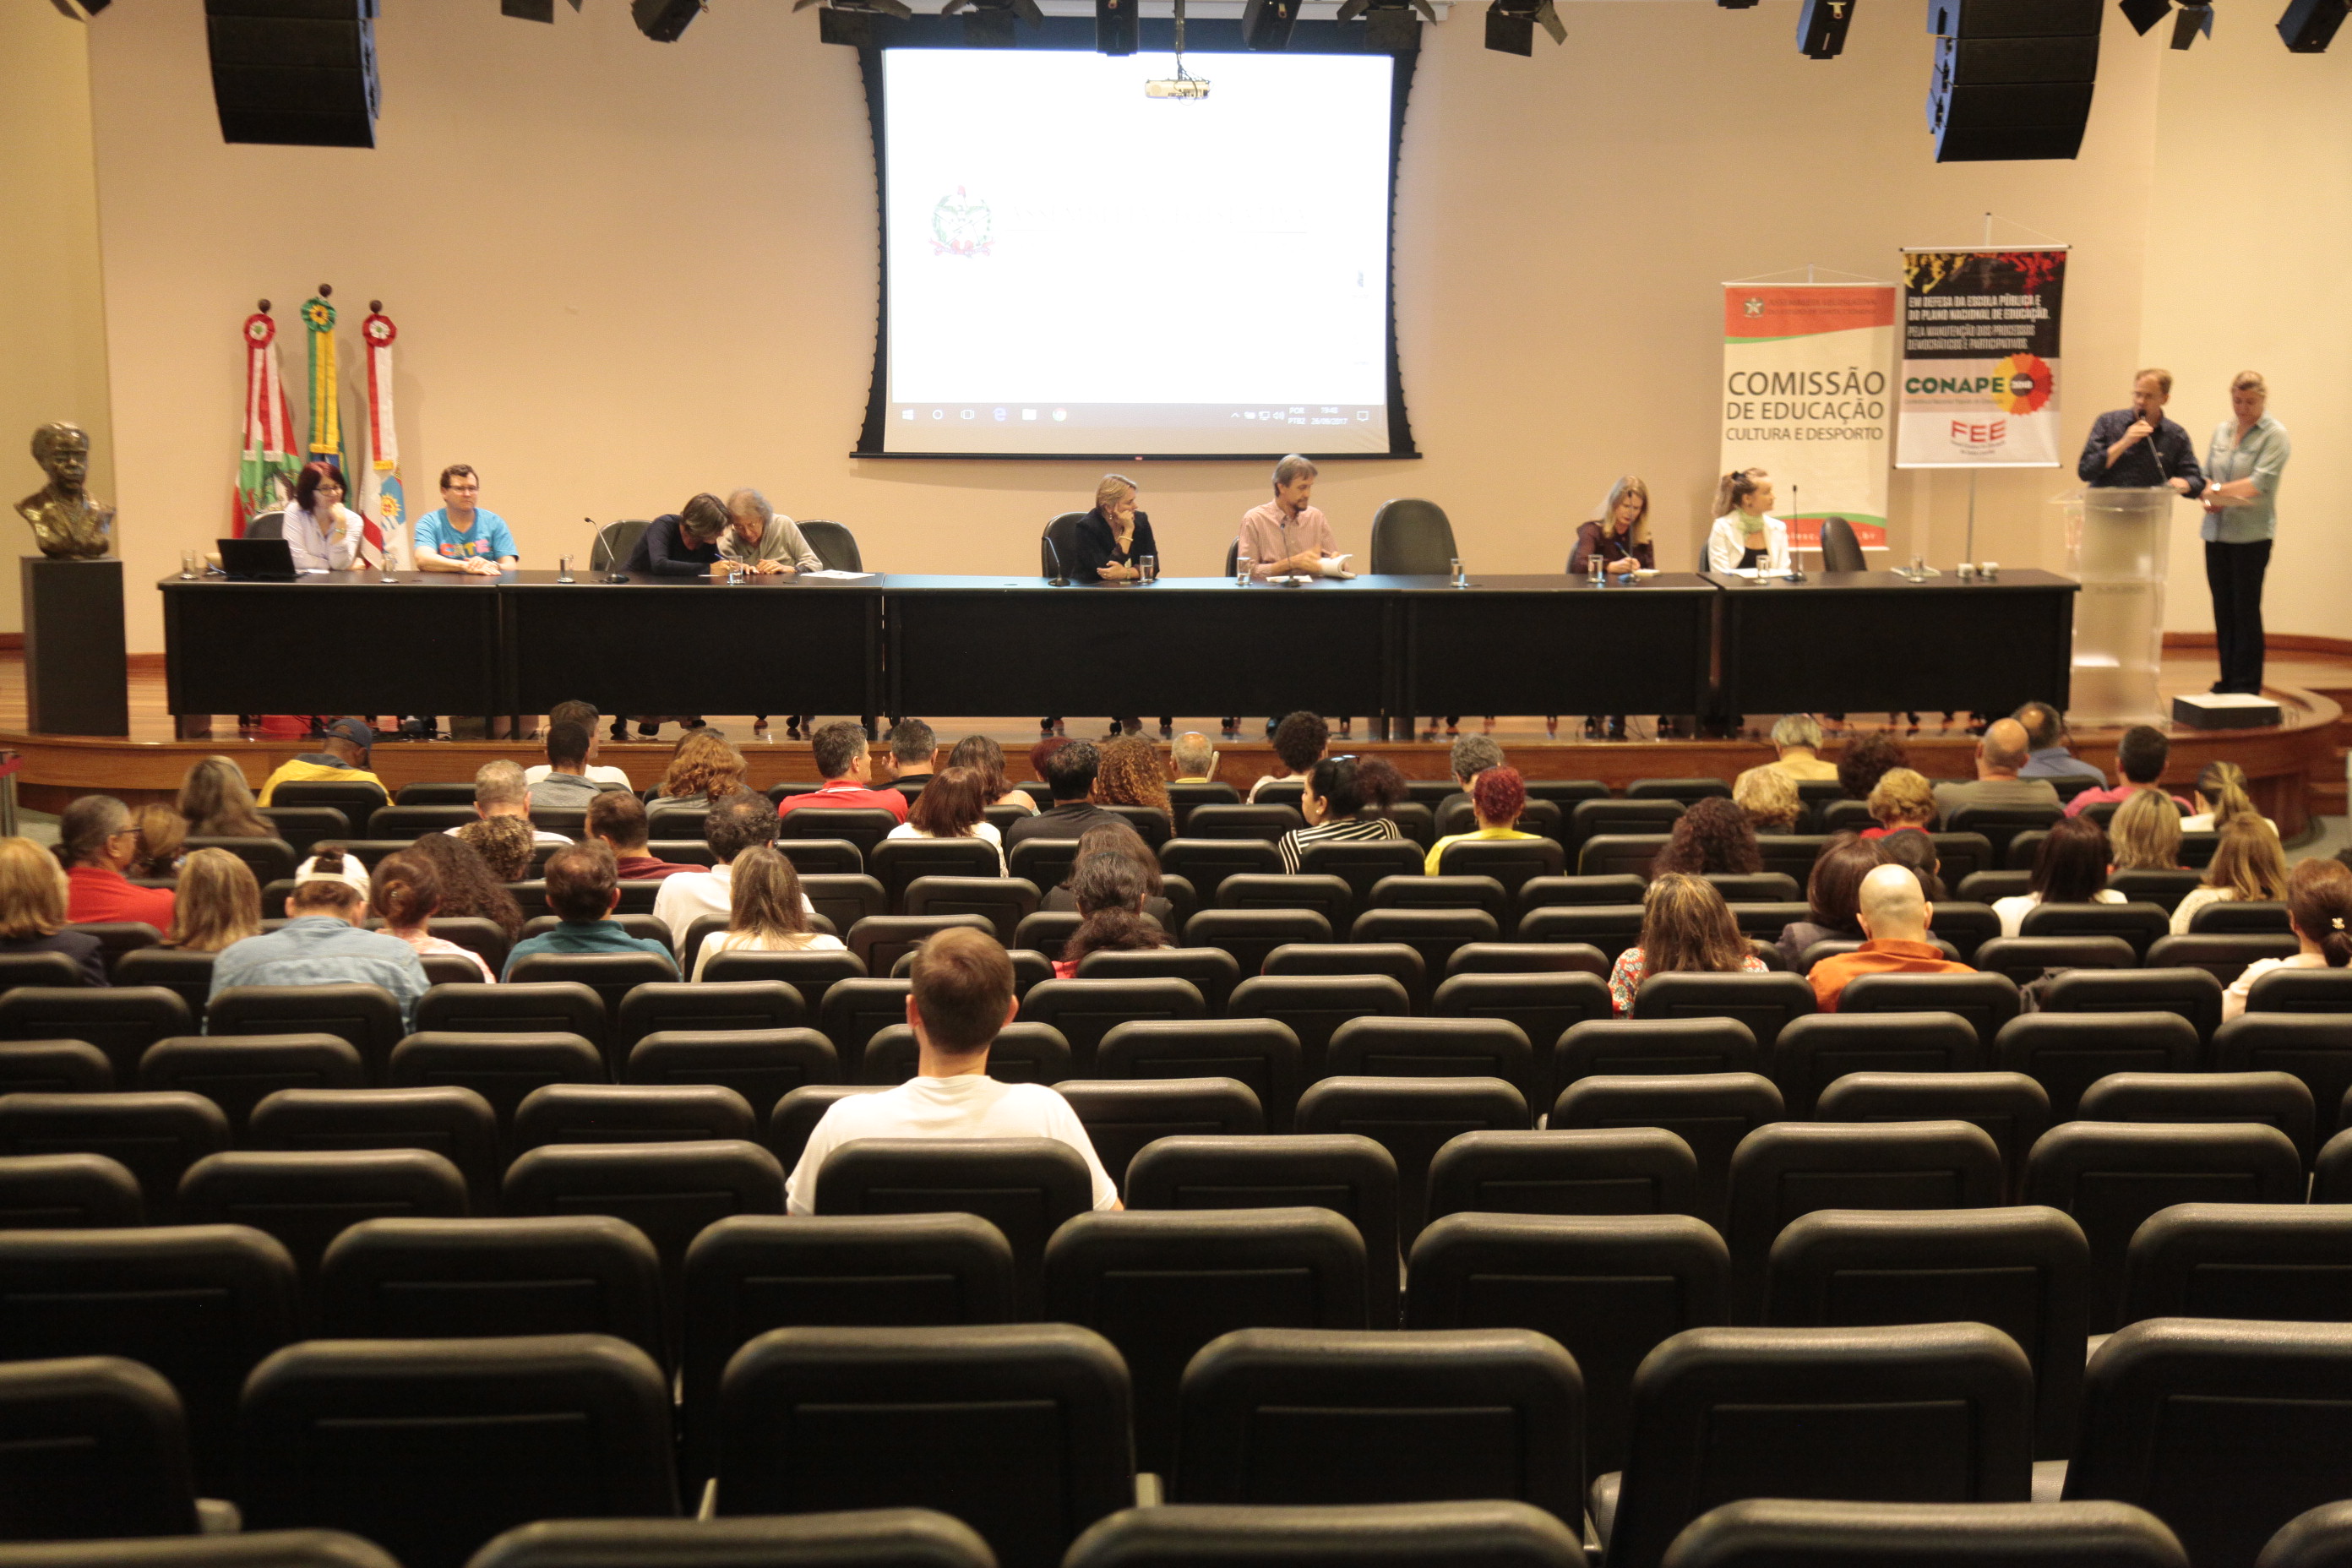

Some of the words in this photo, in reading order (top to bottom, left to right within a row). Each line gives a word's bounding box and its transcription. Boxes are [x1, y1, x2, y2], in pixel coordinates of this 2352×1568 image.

[1908, 297, 1922, 308] EM
[1923, 296, 1953, 308] DEFESA
[1954, 296, 1966, 308] DA
[1967, 295, 1997, 307] ESCOLA
[1998, 292, 2034, 307] PÚBLICA
[2035, 295, 2041, 307] E
[1908, 309, 1920, 320] DO
[1921, 309, 1948, 320] PLANO
[1949, 308, 1990, 320] NACIONAL
[1991, 308, 2003, 319] DE
[1729, 366, 1885, 395] COMISSÃO
[1905, 377, 2005, 395] CONAPE
[1727, 402, 1755, 419] DE
[1761, 398, 1884, 425] EDUCAÇÃO
[1726, 427, 1791, 440] CULTURA
[1794, 427, 1804, 440] E
[1806, 427, 1883, 440] DESPORTO
[1952, 420, 2006, 443] FEE
